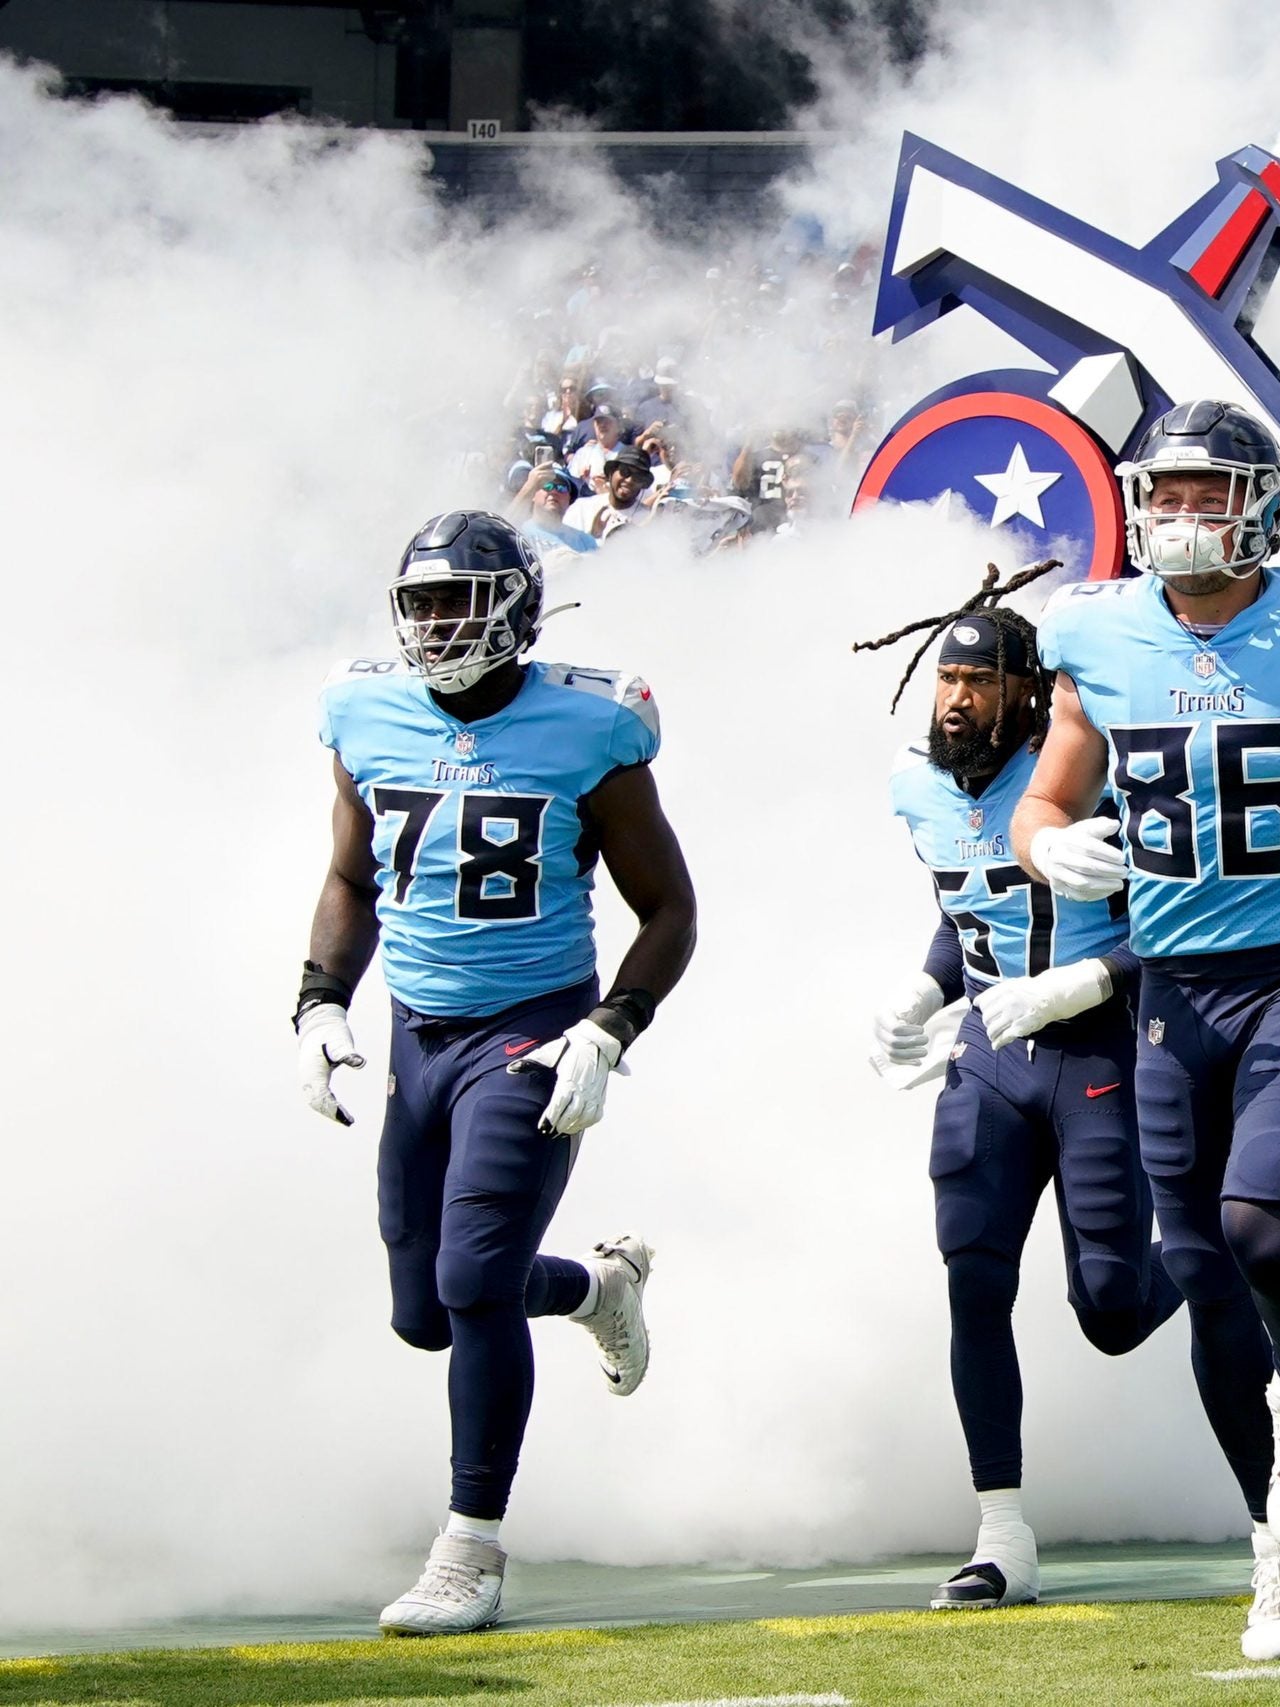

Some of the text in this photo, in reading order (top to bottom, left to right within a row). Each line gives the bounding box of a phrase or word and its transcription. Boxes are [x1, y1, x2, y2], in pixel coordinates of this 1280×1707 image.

[471, 122, 497, 139] 140
[1168, 685, 1245, 716] TITANS
[432, 757, 495, 785] TITANS
[370, 783, 555, 923] 78
[954, 833, 1006, 861] TITANS
[931, 861, 1057, 980] 57
